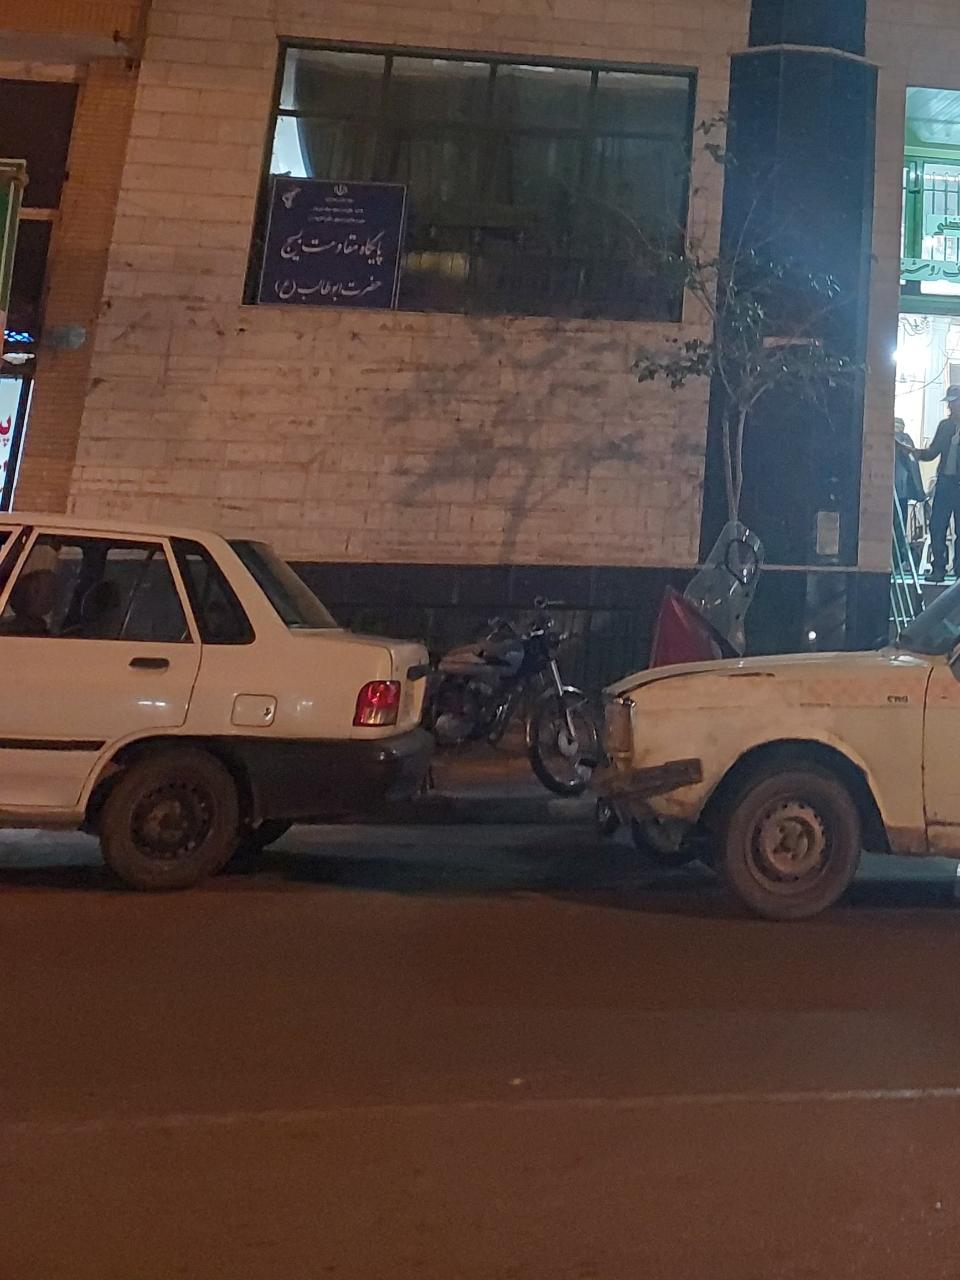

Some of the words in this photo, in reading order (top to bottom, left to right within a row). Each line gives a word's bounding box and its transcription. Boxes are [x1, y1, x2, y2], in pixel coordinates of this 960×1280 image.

[280, 230, 303, 262] بسیج
[302, 233, 358, 256] مقاومت
[359, 230, 385, 266] پایگاه
[298, 279, 342, 301] ابوطالب
[341, 275, 382, 297] حضرت
